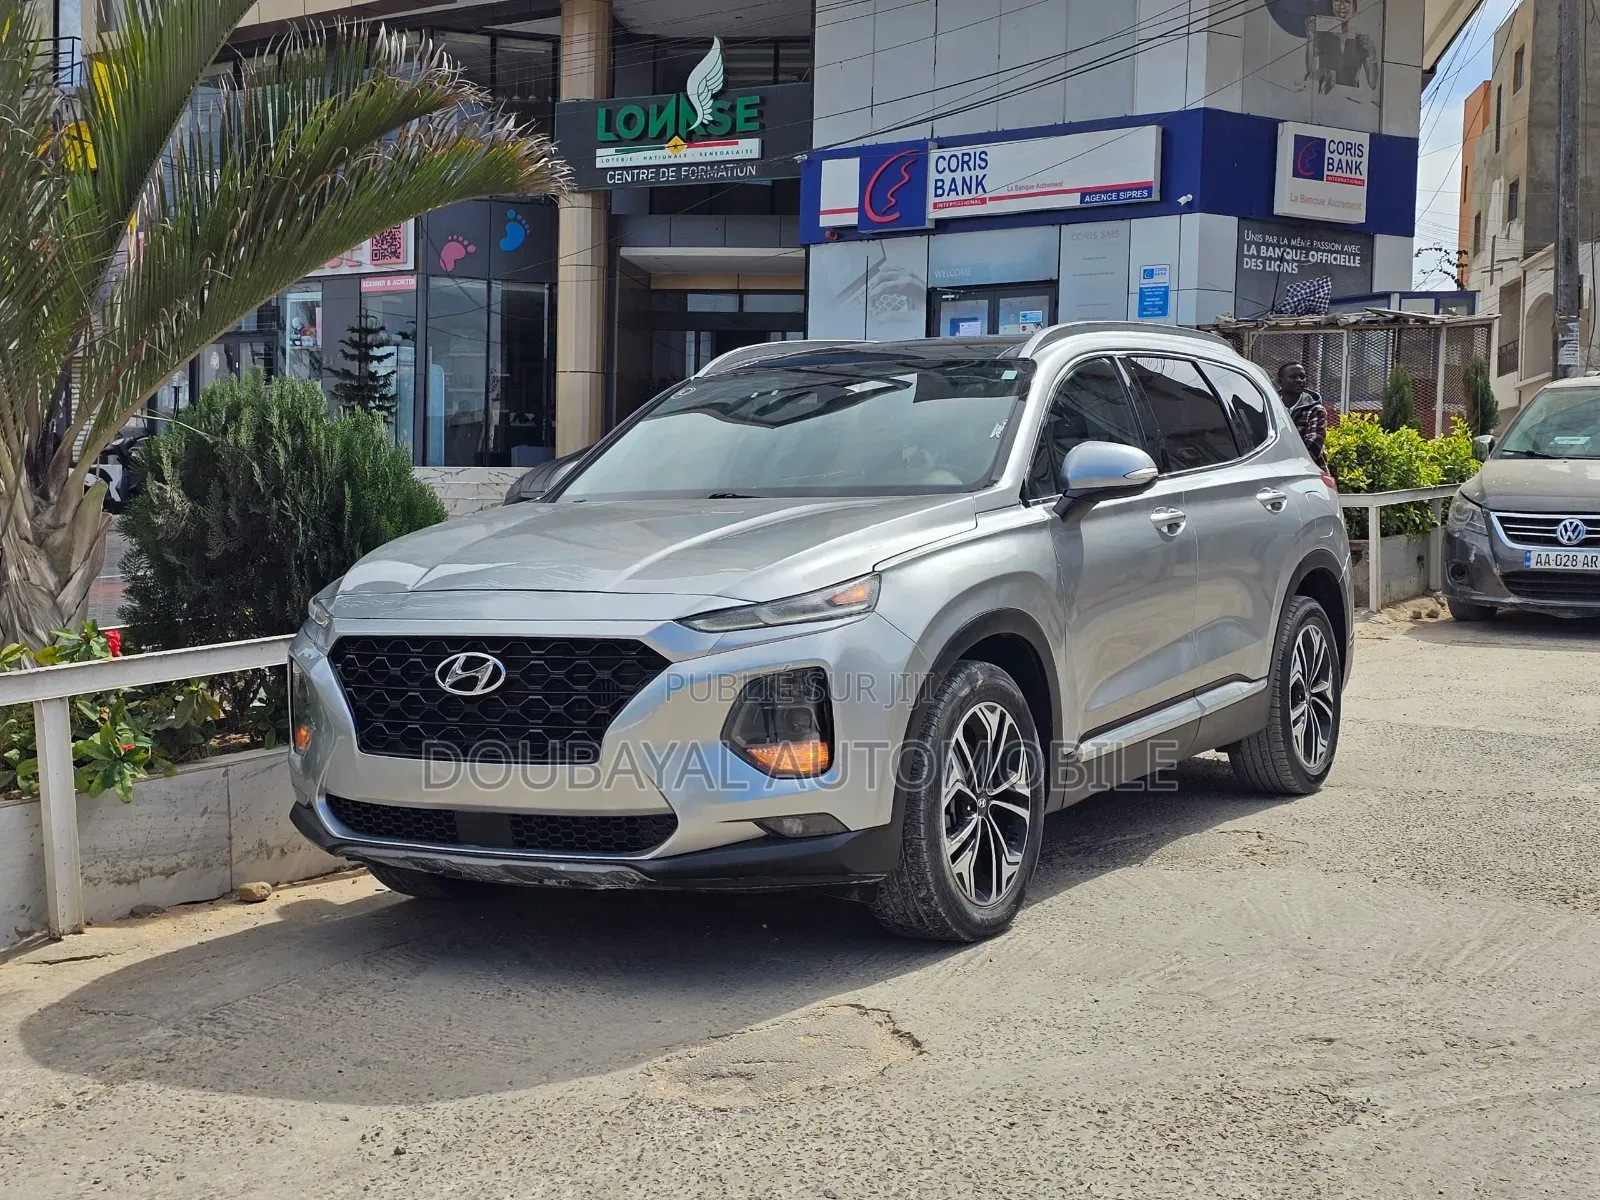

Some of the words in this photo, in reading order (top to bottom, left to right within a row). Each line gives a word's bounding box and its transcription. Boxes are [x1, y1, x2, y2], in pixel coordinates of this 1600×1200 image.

[597, 92, 760, 141] LONASE
[643, 152, 688, 161] NATIONALE
[1328, 139, 1364, 158] CORIS
[935, 150, 989, 174] CORIS
[1326, 156, 1363, 176] BANK
[606, 168, 656, 184] CENTRE
[659, 167, 677, 181] DE
[681, 164, 757, 180] FORMATION
[1327, 174, 1364, 186] INTERNATIONAL
[934, 173, 987, 198] BANK
[1014, 183, 1035, 192] Banque
[1036, 180, 1064, 189] Autrement
[936, 199, 981, 208] INTERNATIONAL
[1084, 192, 1118, 203] AGENCE
[1119, 189, 1148, 200] SIPRES
[1290, 193, 1298, 203] La
[1300, 194, 1325, 207] Banque
[1327, 198, 1362, 210] Autrement
[1071, 231, 1098, 241] CORIS
[1100, 229, 1120, 239] SMS
[1265, 235, 1277, 244] PAR
[1280, 237, 1288, 245] LA
[1291, 236, 1311, 248] MÊME
[1313, 240, 1341, 251] PASSION
[1343, 244, 1361, 254] AVEC
[1243, 244, 1257, 255] LA
[1260, 246, 1306, 262] BANQUE
[1308, 250, 1361, 267] OFFICIELLE
[934, 267, 973, 278] WELCOME
[1243, 258, 1263, 271] DES
[1266, 260, 1299, 274] LIONS
[386, 279, 392, 287] &
[392, 278, 415, 286] ACHETER
